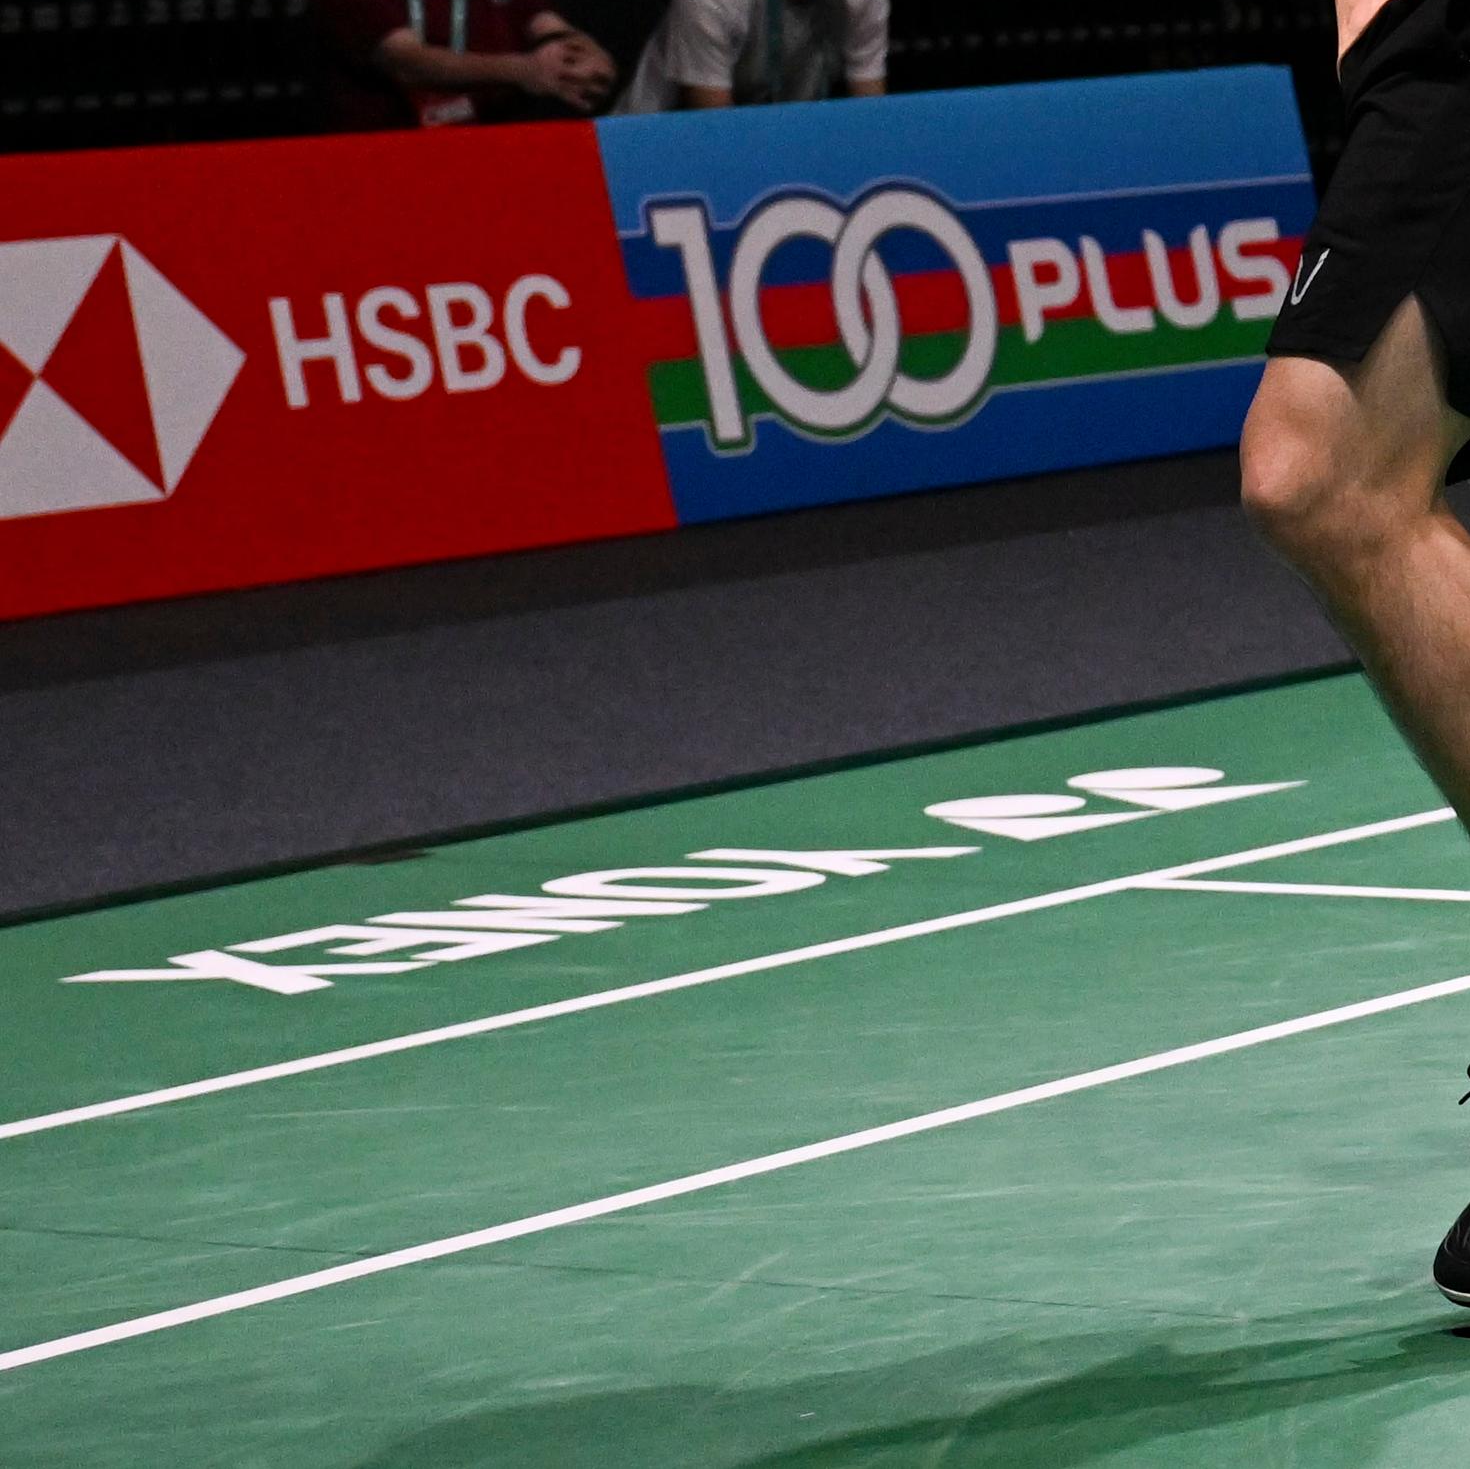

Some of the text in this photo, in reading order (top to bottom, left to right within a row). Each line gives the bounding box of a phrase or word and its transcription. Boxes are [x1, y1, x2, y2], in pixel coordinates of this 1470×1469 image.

[269, 273, 582, 409] HSBC
[650, 188, 1292, 442] 100 PLUS
[60, 845, 983, 995] YONEX
